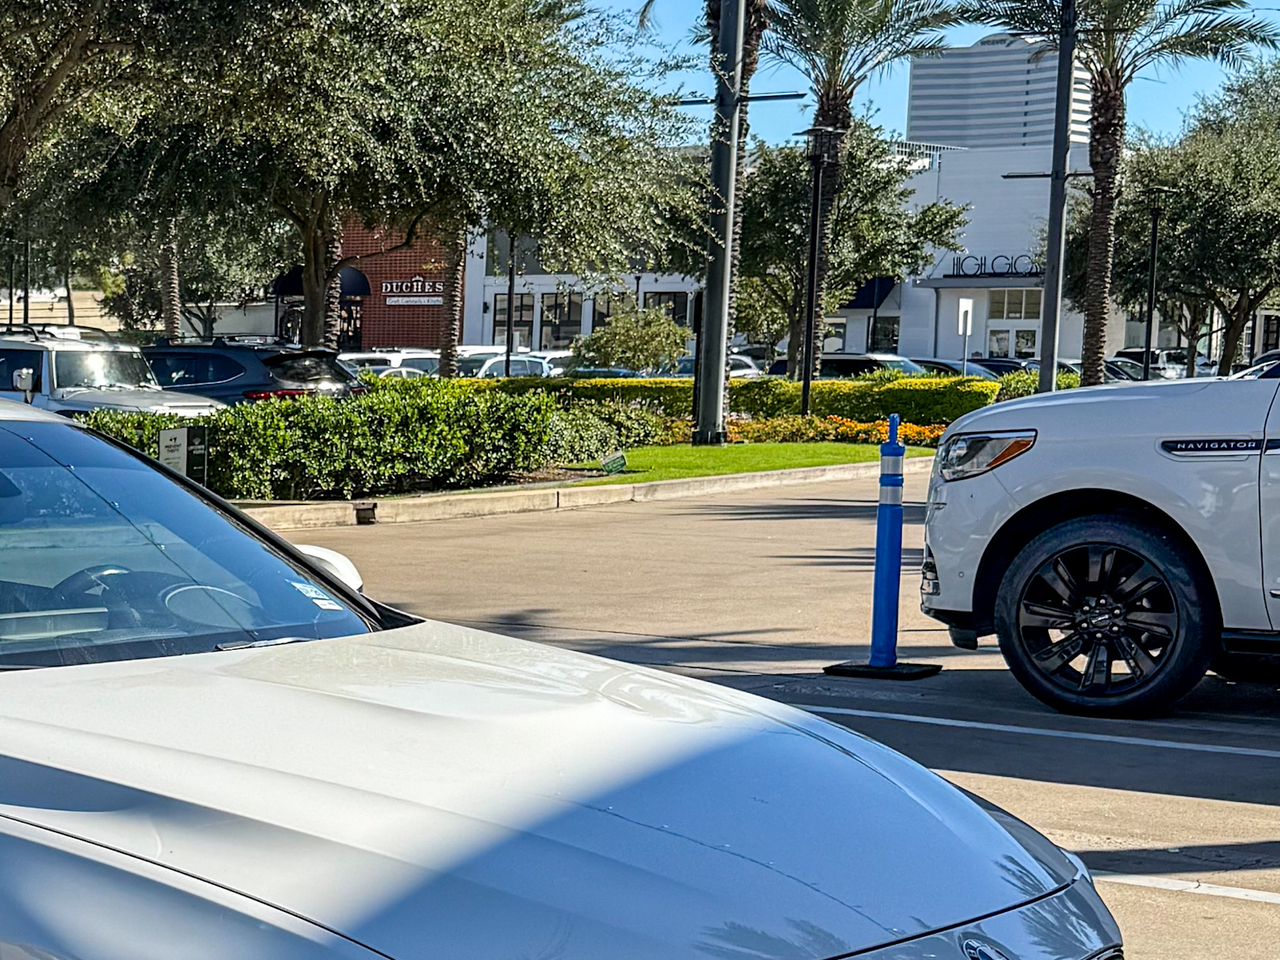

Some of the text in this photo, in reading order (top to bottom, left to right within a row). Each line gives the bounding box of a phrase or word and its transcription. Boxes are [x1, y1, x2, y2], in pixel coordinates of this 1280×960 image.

[952, 256, 987, 276] HIGH
[381, 282, 444, 293] DUCHES
[1177, 441, 1257, 450] NAVIGATOR
